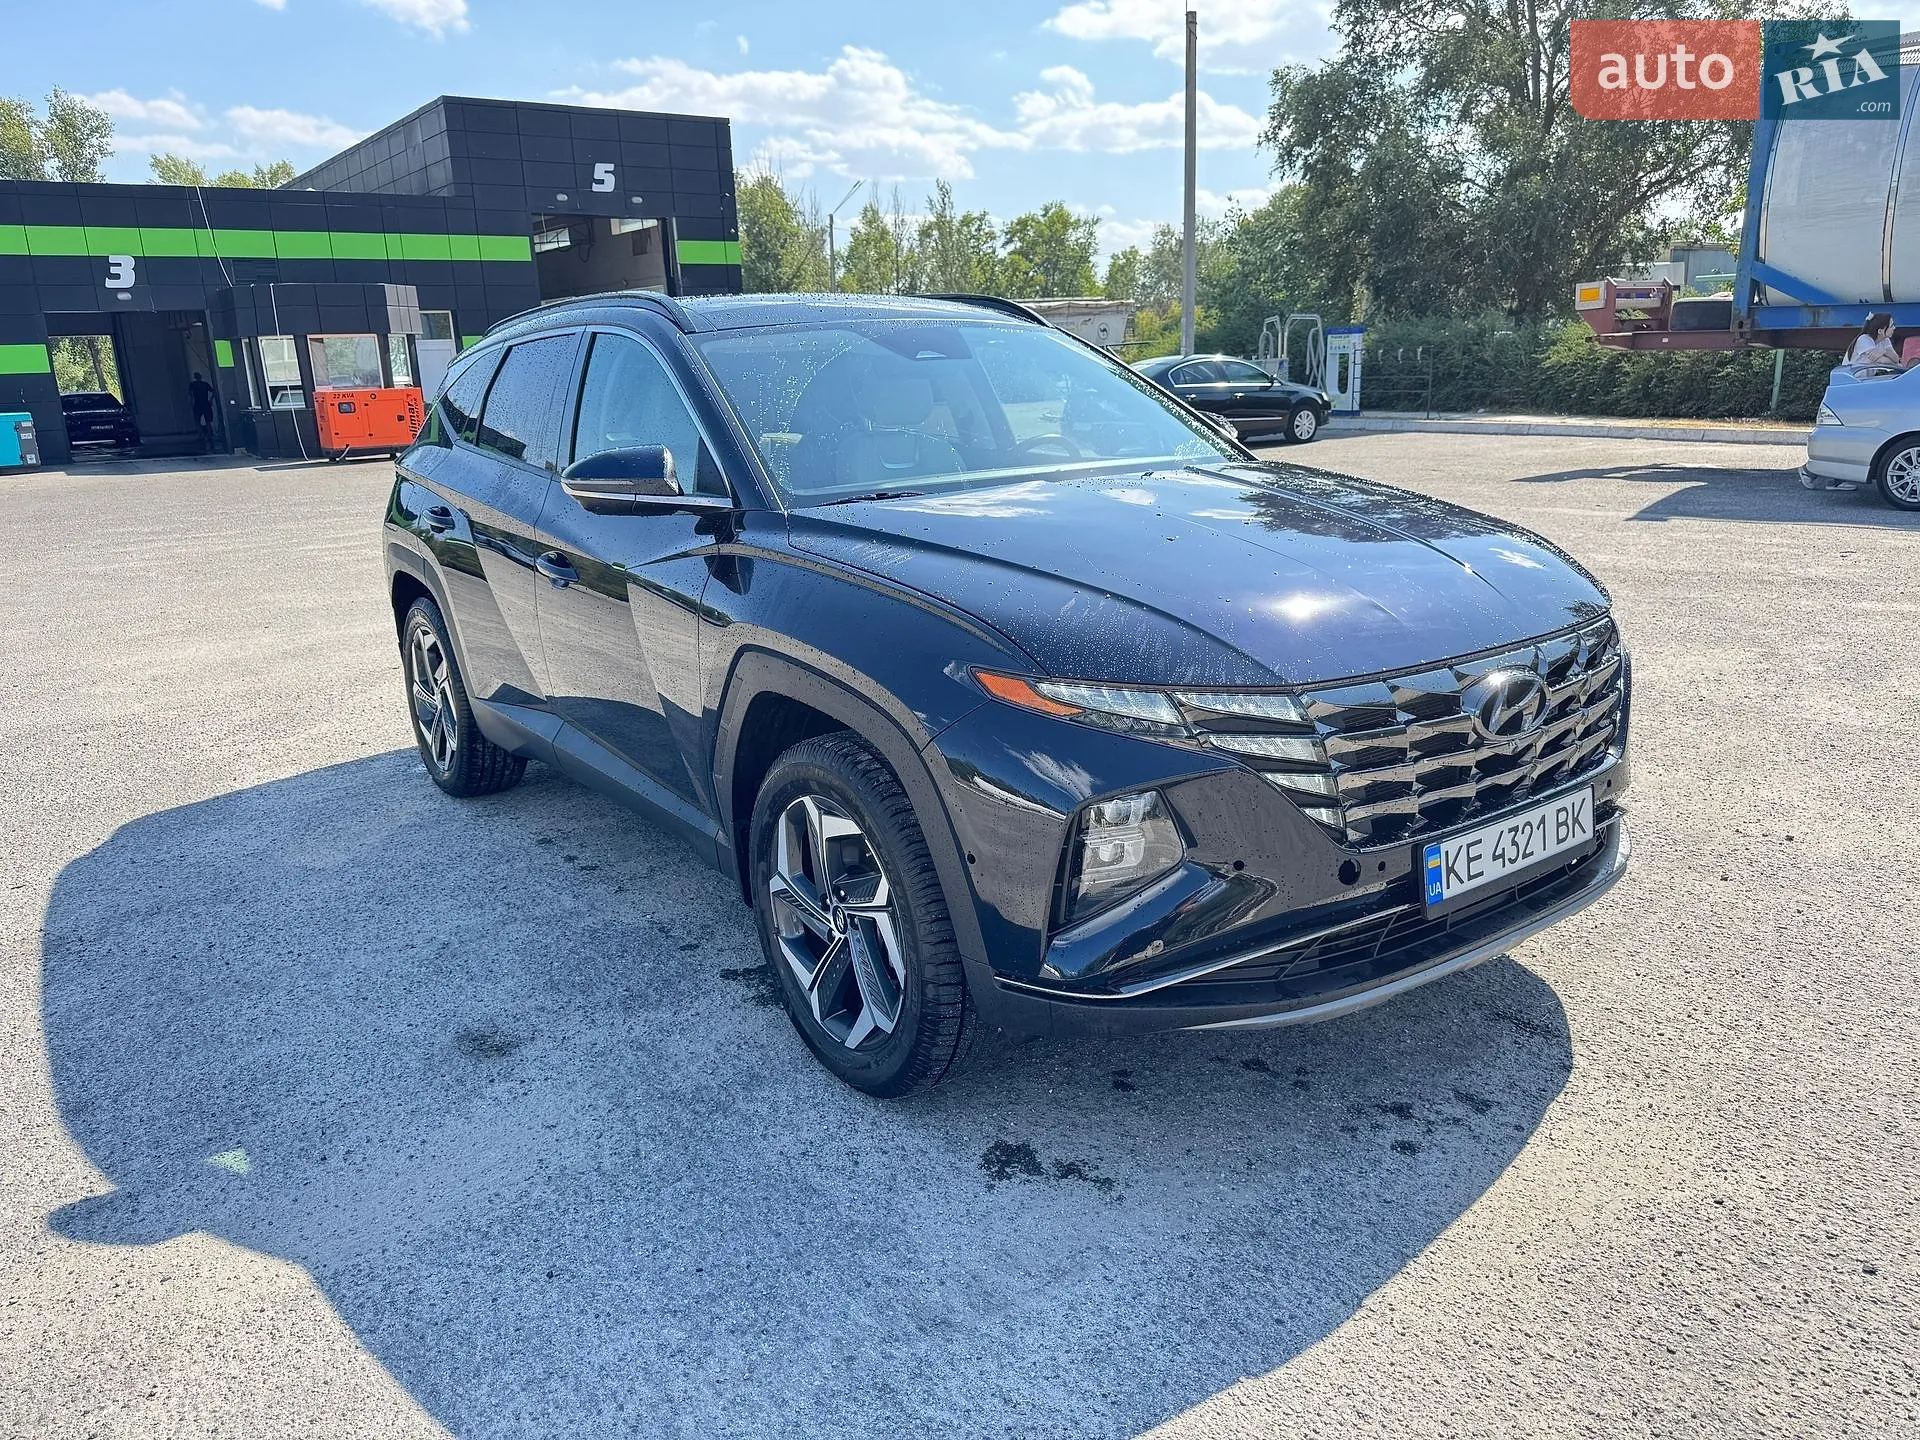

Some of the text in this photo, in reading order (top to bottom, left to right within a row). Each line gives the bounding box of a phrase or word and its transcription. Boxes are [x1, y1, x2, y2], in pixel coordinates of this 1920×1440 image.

[591, 163, 616, 193] 5
[105, 255, 136, 289] 3
[1444, 797, 1587, 890] KE 4321 BK
[1429, 882, 1442, 896] UA
